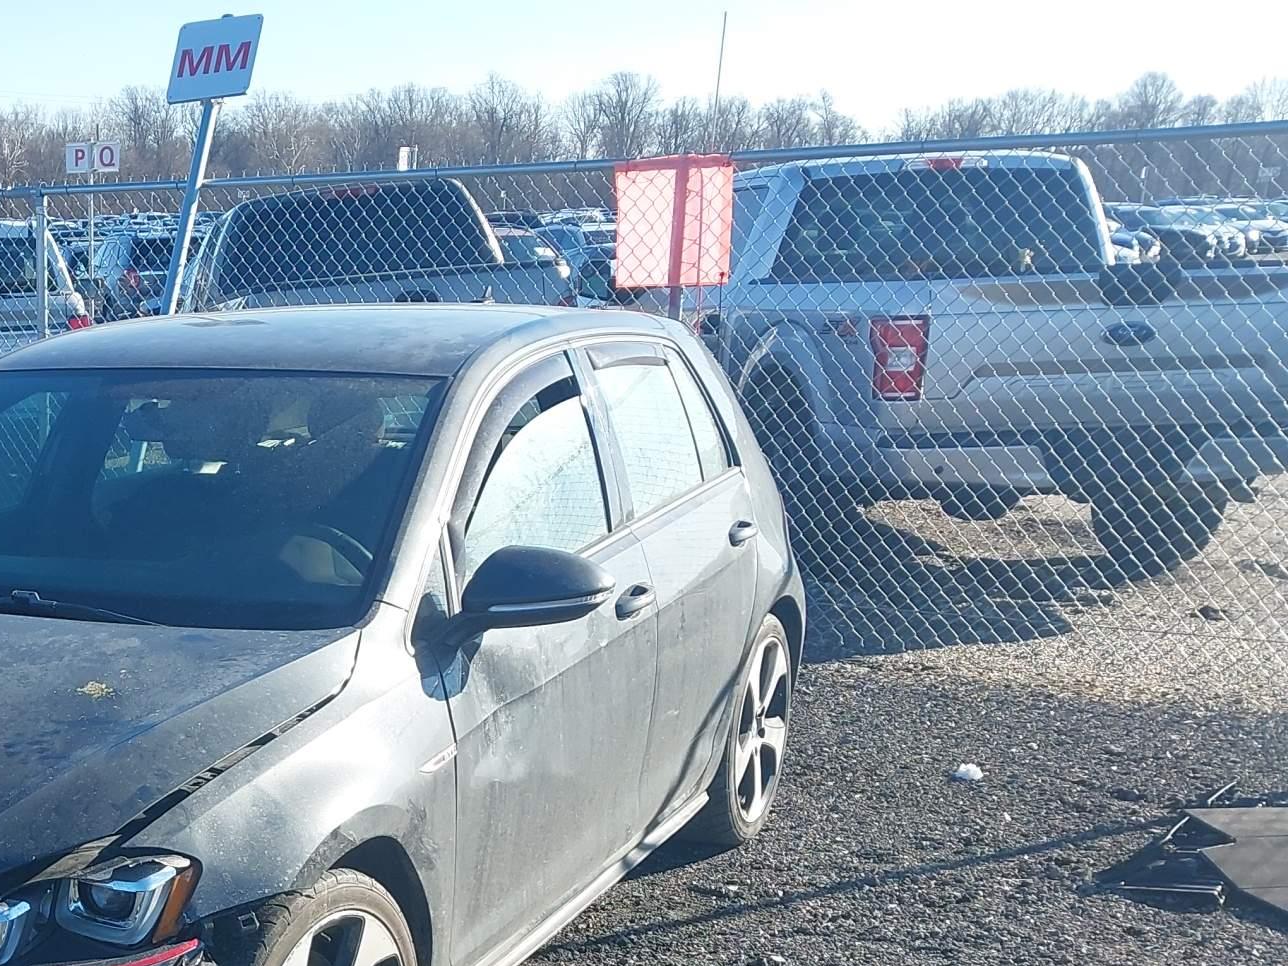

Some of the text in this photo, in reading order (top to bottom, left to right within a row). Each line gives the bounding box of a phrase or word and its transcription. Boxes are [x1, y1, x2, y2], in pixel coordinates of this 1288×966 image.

[177, 40, 252, 78] MM
[74, 148, 86, 167] P
[99, 145, 116, 167] Q
